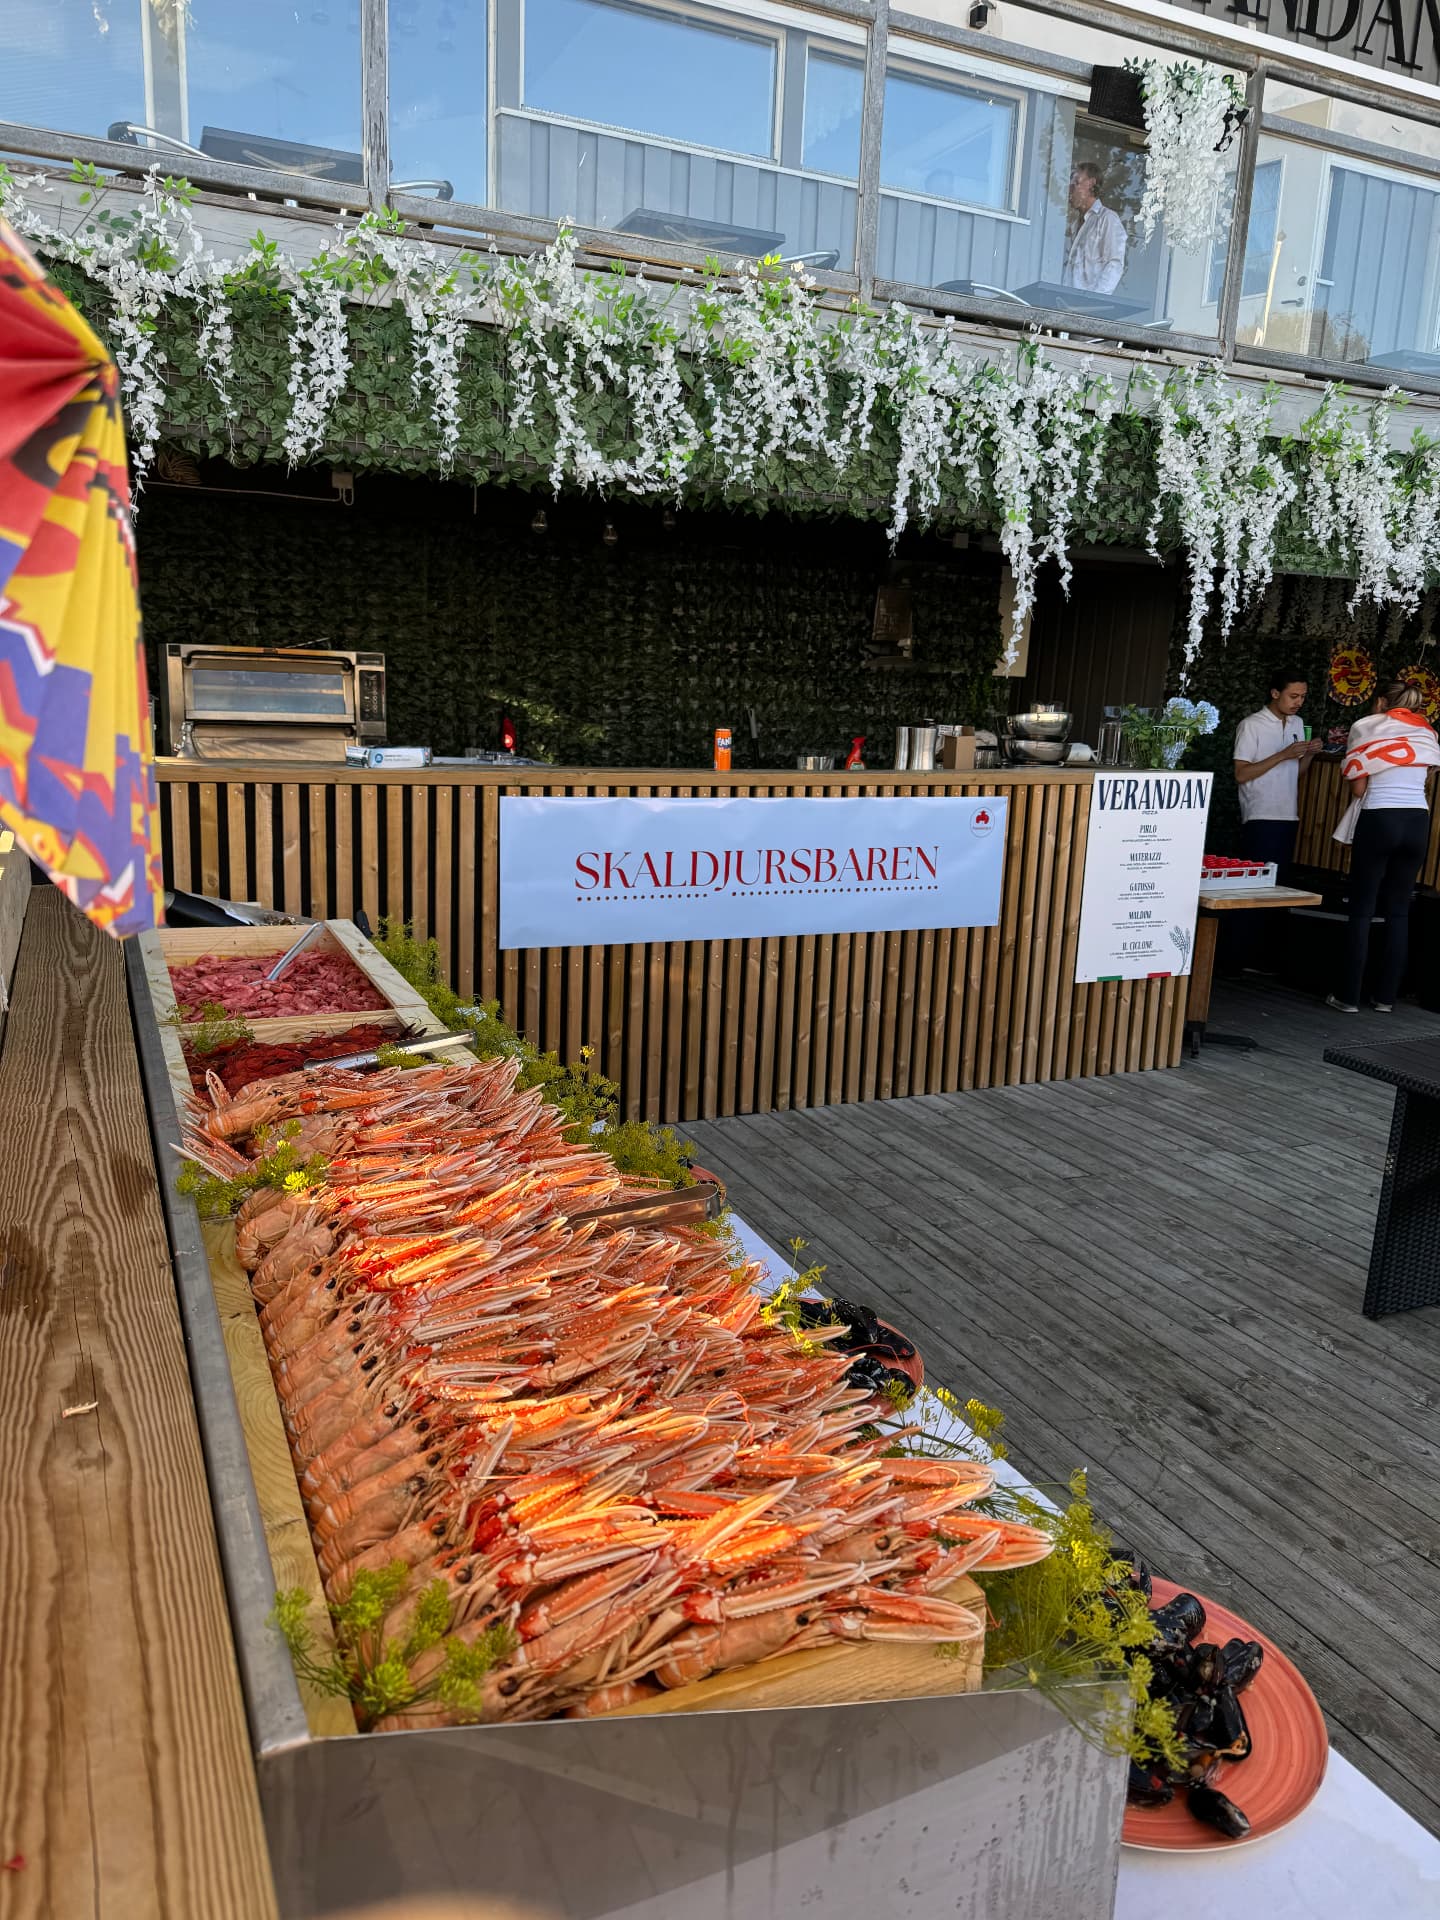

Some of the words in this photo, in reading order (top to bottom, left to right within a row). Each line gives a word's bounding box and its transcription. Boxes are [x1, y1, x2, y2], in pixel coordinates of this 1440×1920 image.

[1098, 778, 1209, 811] VERANDAN
[1139, 824, 1158, 834] PIRLO
[1130, 851, 1162, 862] MATERAZZI
[574, 845, 940, 892] SKALDJURSBAREN
[1128, 910, 1152, 920] MALDINI
